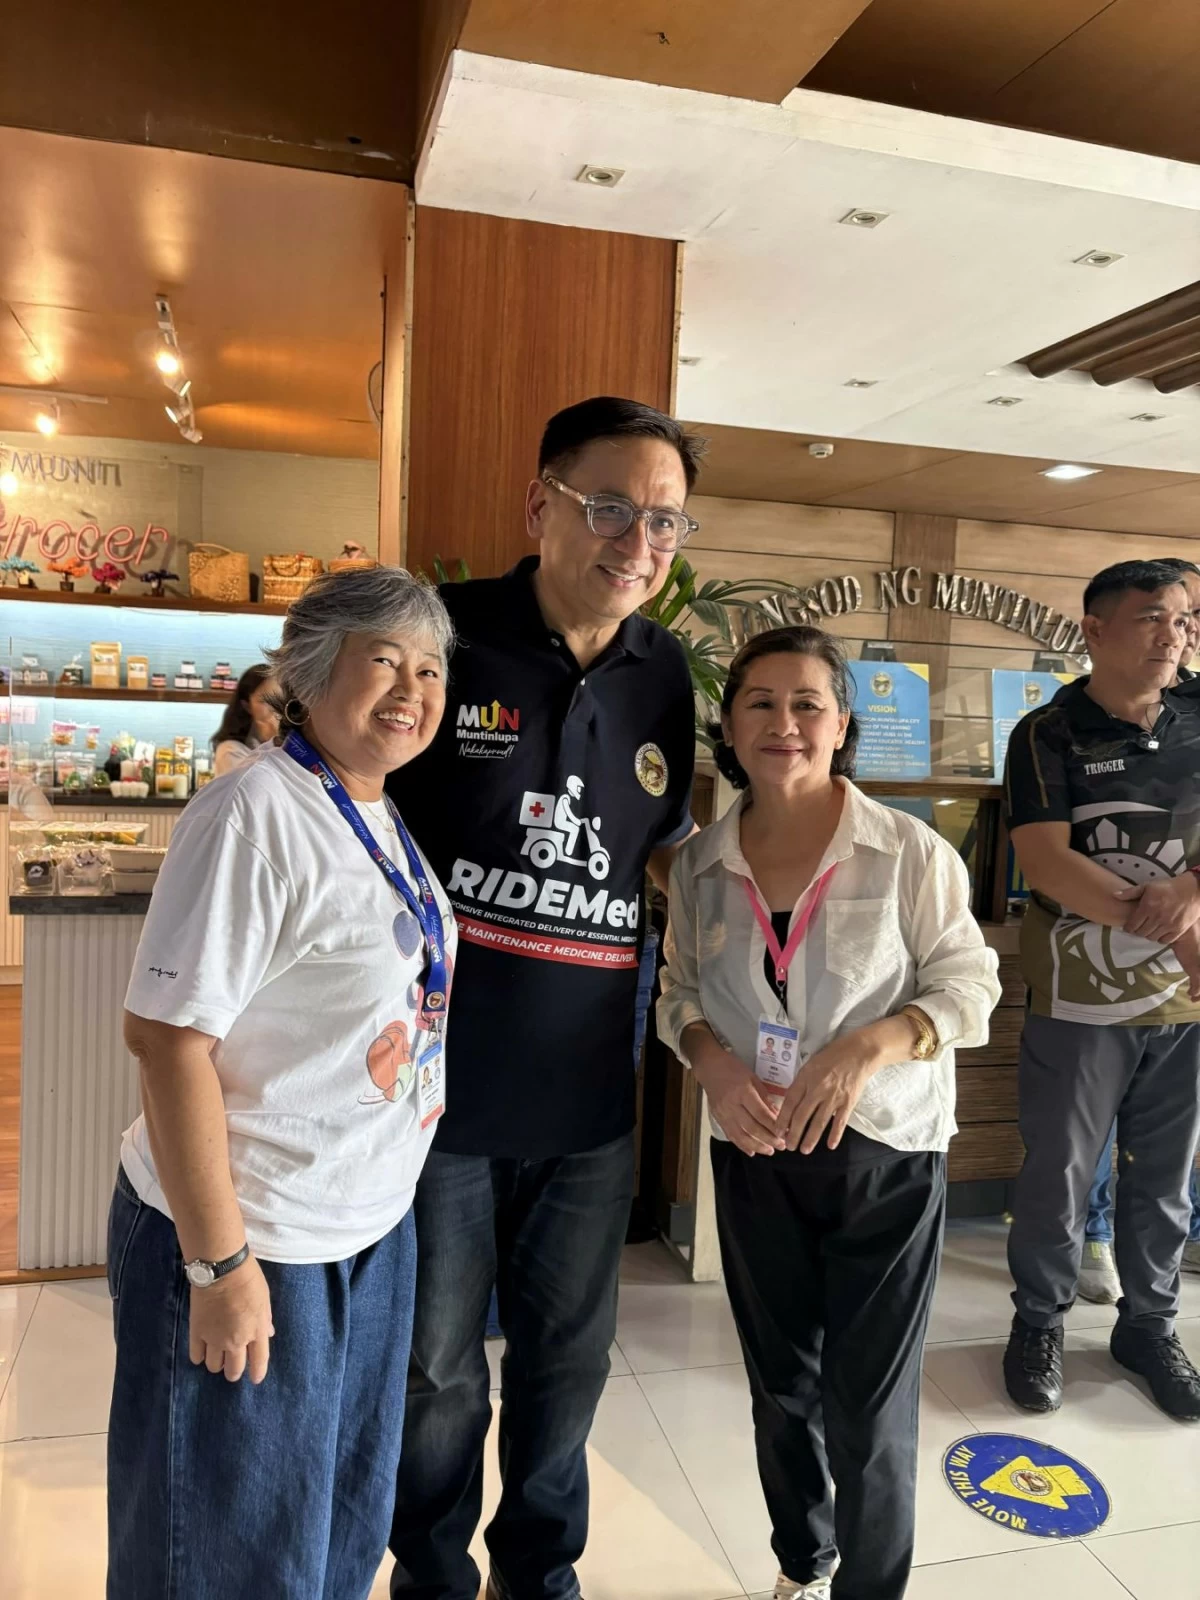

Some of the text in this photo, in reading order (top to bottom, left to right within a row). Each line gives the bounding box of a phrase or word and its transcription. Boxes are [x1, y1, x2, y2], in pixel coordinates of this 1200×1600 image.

[0, 514, 169, 565] rocer
[878, 566, 923, 611] NG
[457, 700, 519, 731] MUN
[867, 704, 897, 713] VISION
[457, 729, 519, 743] Muntinlupa
[1084, 759, 1125, 775] TRIGGER
[446, 858, 639, 929] RIDEMed
[466, 925, 552, 953] MAINTENANCE
[553, 945, 605, 960] MEDICINE
[484, 911, 536, 928] INTEGRATED
[537, 923, 576, 936] DELIVERY
[588, 931, 620, 943] ESSENTIAL
[949, 1444, 1028, 1530] MOVE THIS WAY
